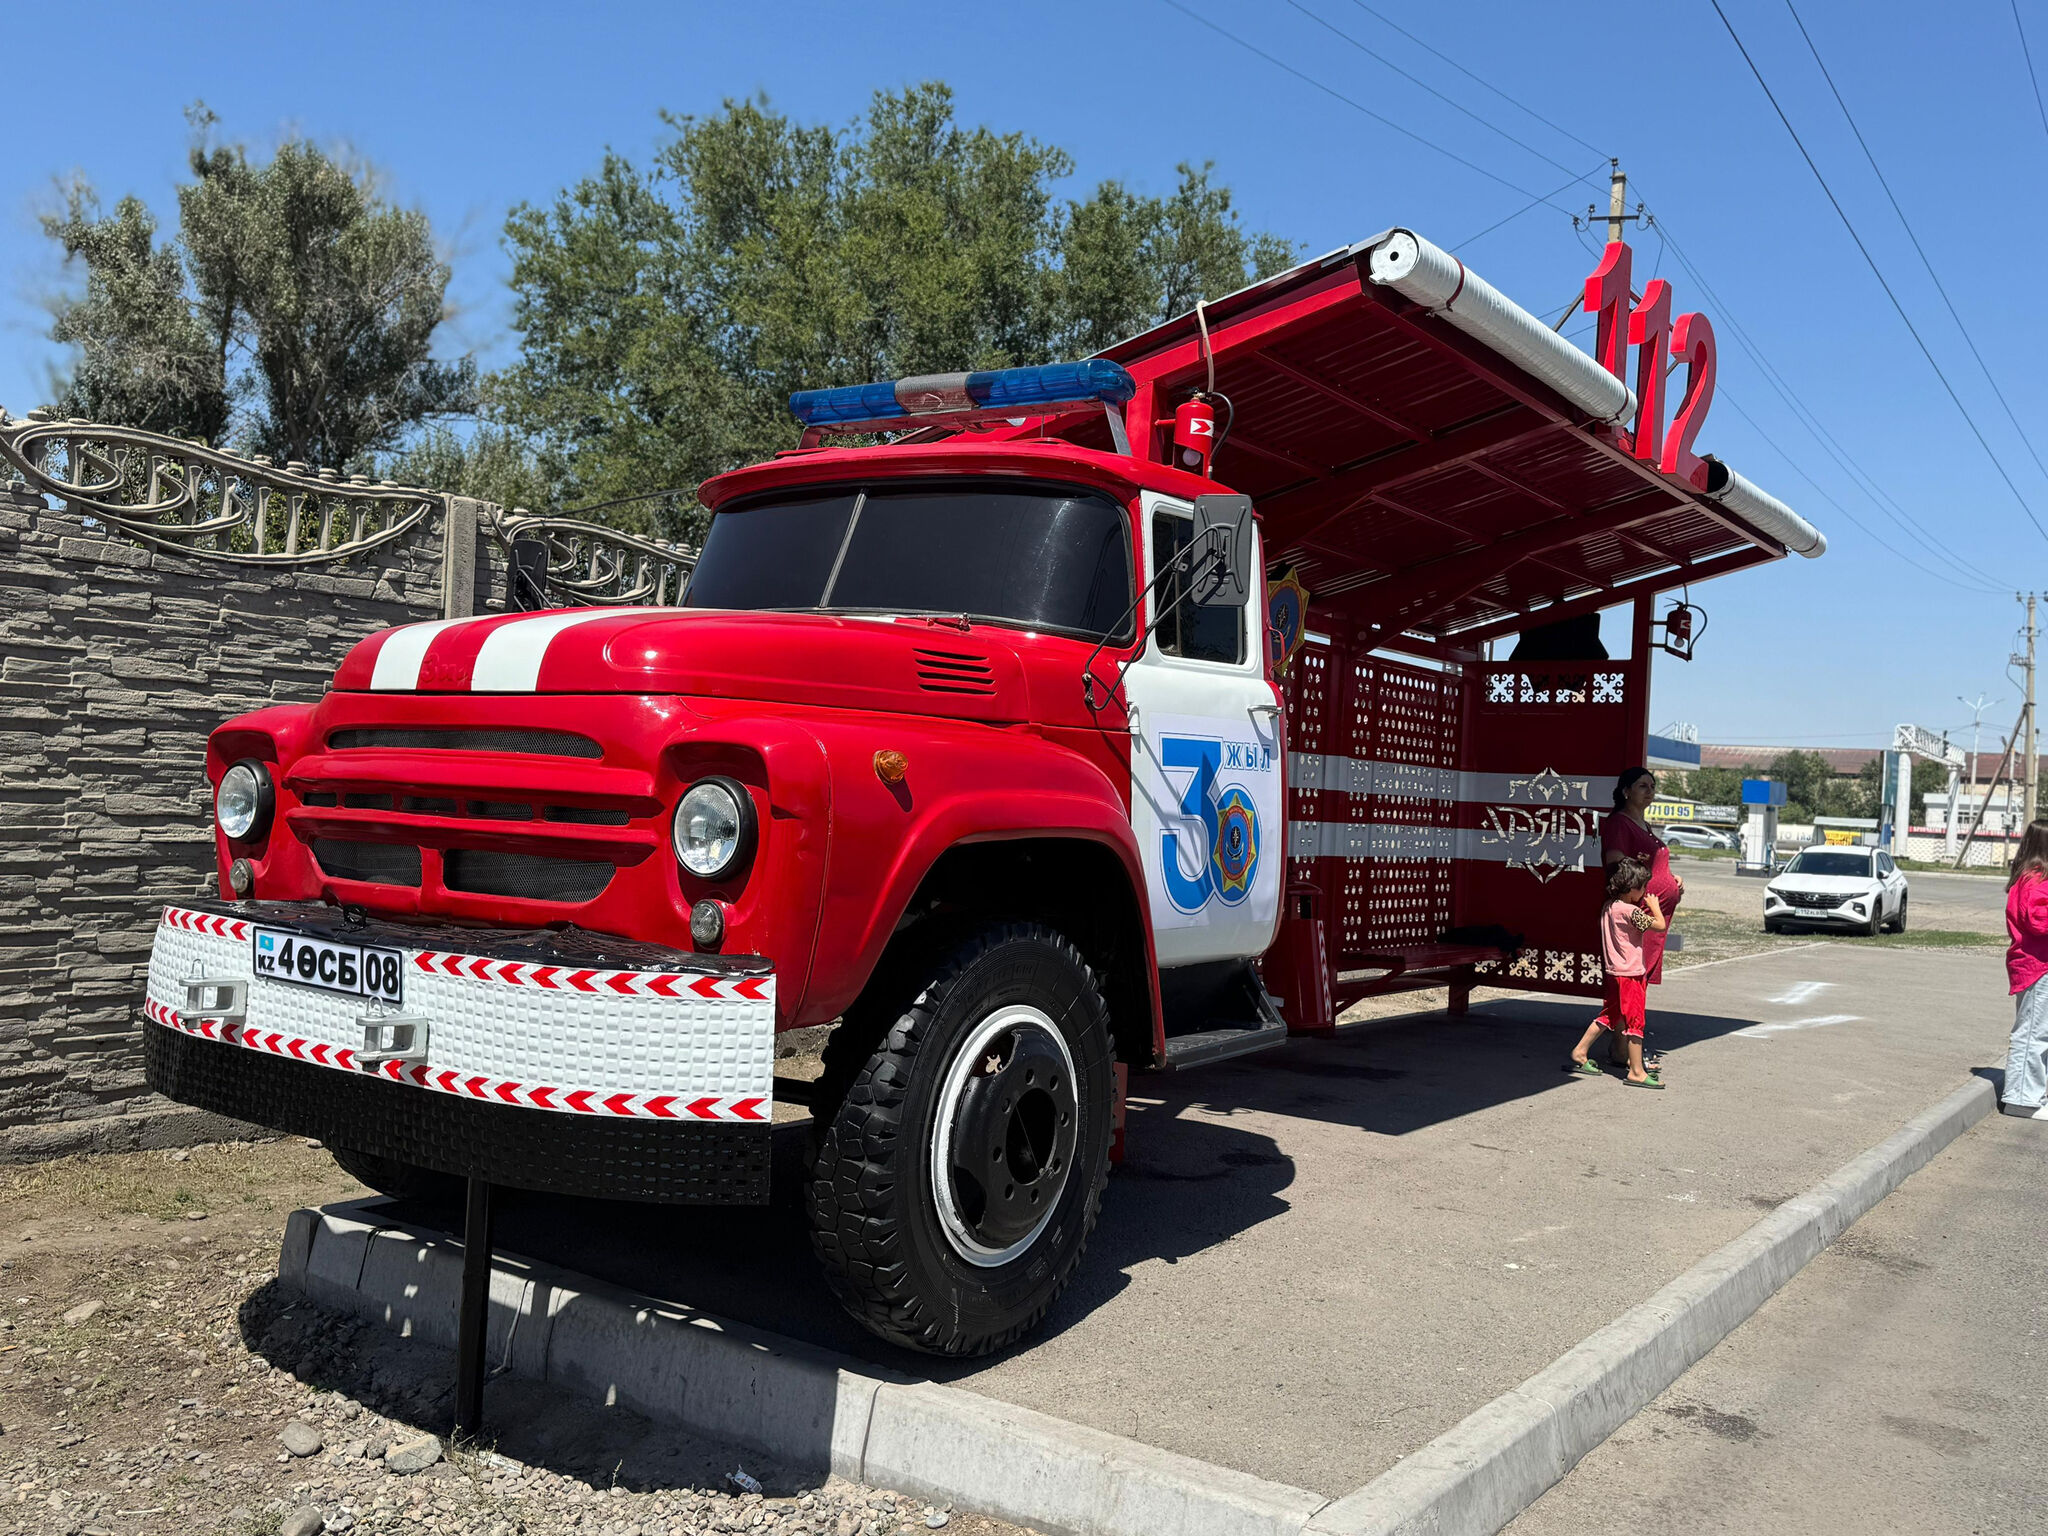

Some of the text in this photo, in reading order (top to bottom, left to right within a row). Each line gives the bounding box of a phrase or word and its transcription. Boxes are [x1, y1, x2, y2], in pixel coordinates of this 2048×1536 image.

[1583, 241, 1716, 494] 112
[1159, 732, 1262, 915] 30
[1224, 741, 1272, 773] ЖЫЛ
[1663, 805, 1675, 816] 01
[1677, 806, 1690, 817] 95
[258, 954, 275, 971] KZ
[365, 953, 399, 994] 08
